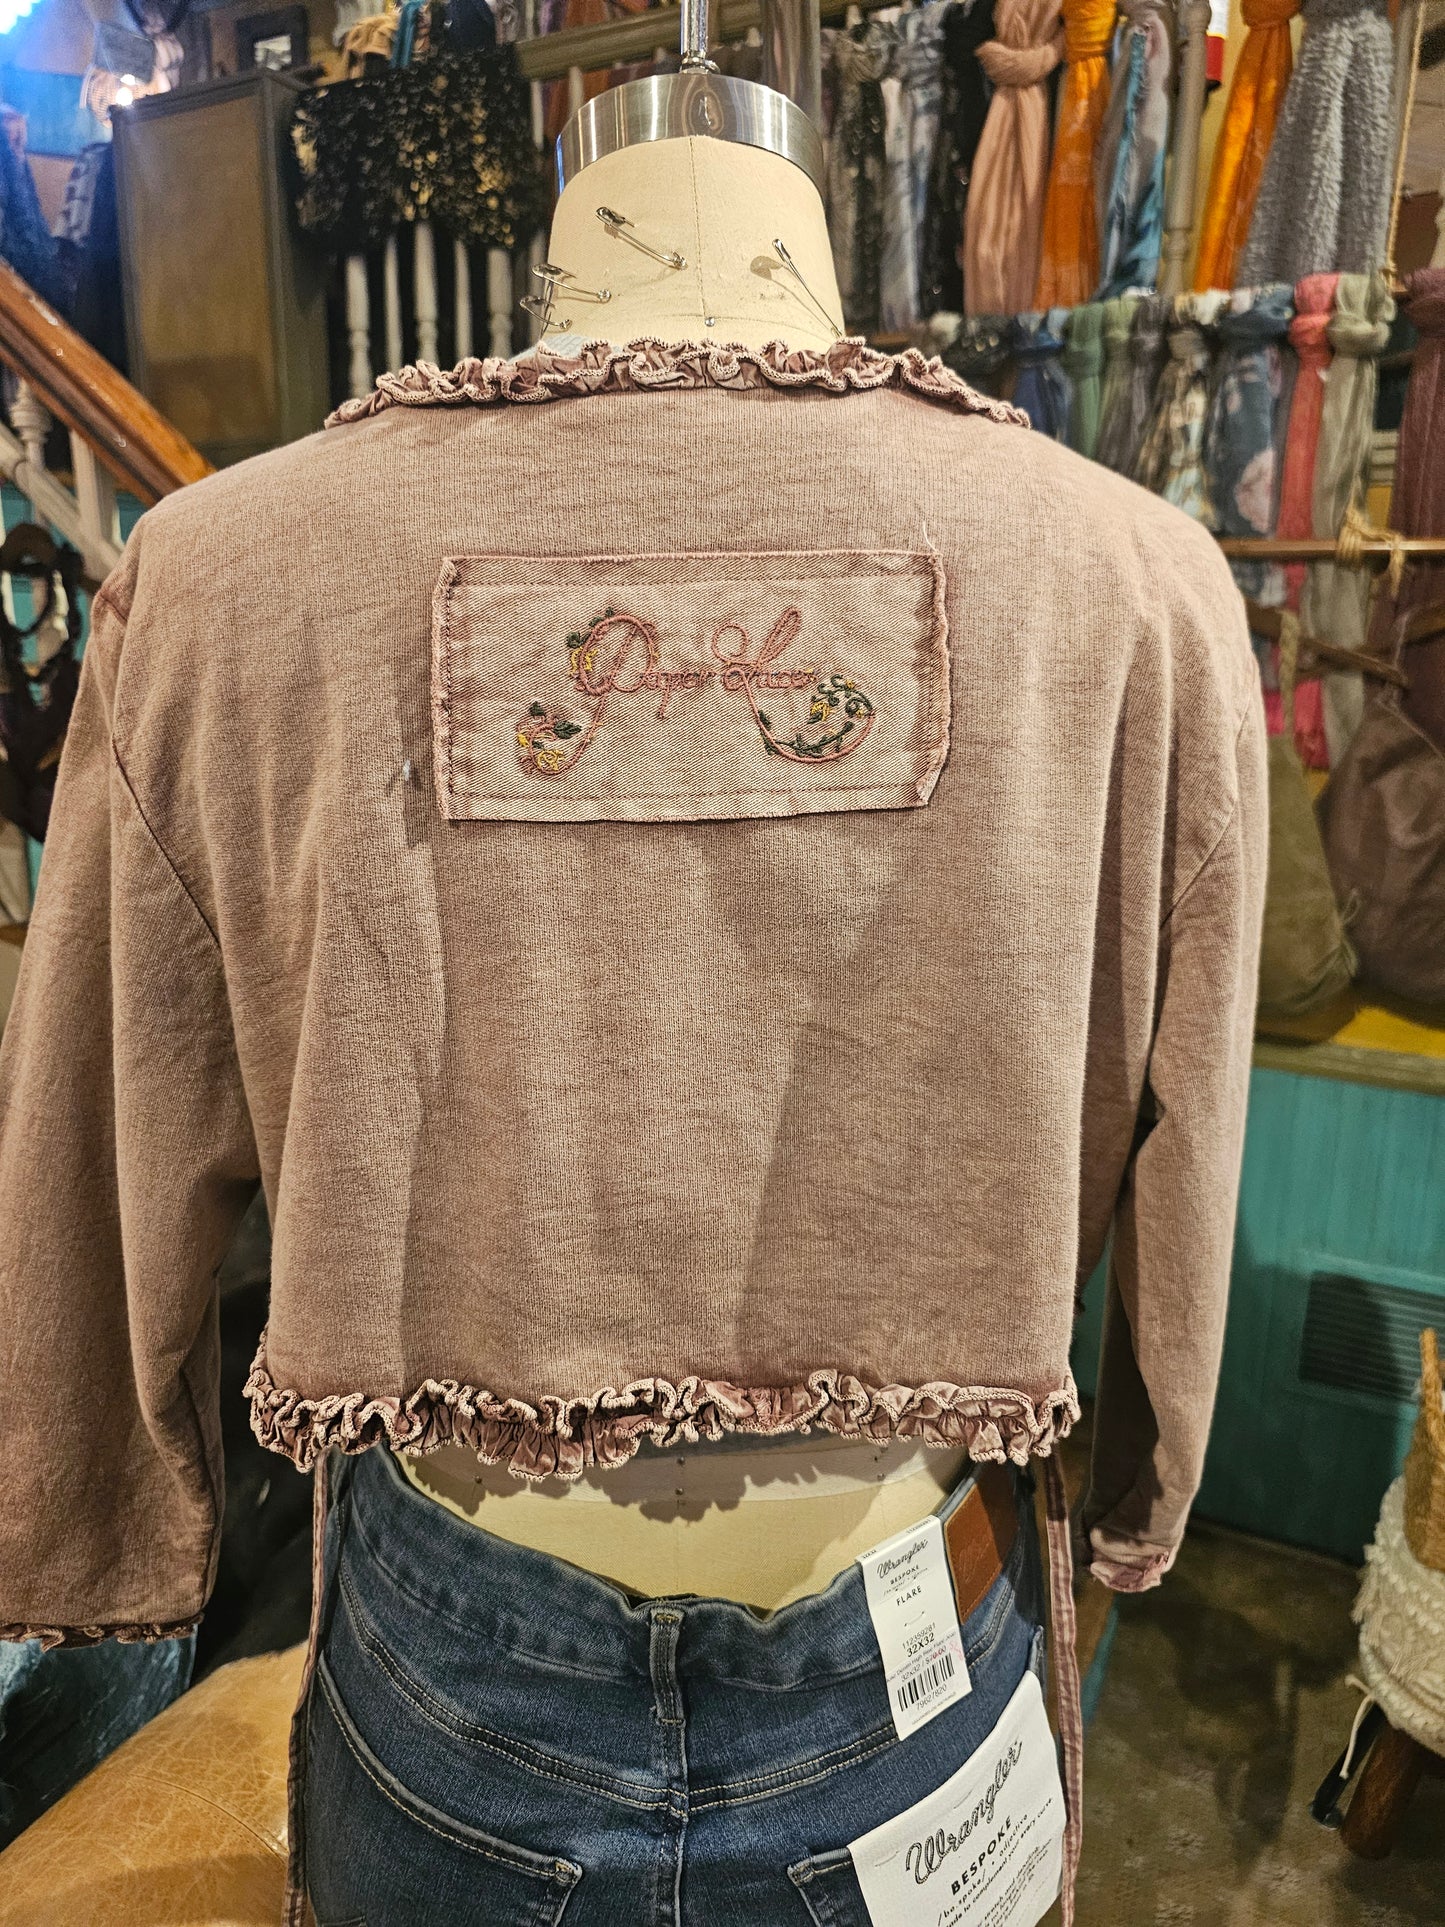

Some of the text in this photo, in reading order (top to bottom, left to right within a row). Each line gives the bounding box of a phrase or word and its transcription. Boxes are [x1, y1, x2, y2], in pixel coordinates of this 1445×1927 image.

[877, 1539, 929, 1580] Wrangler
[890, 1565, 920, 1585] BESPOKE
[896, 1585, 922, 1607] FLARE
[906, 1632, 935, 1657] 32X32
[905, 1738, 1023, 1884] Wrangler
[951, 1815, 1012, 1896] BESPOKE
